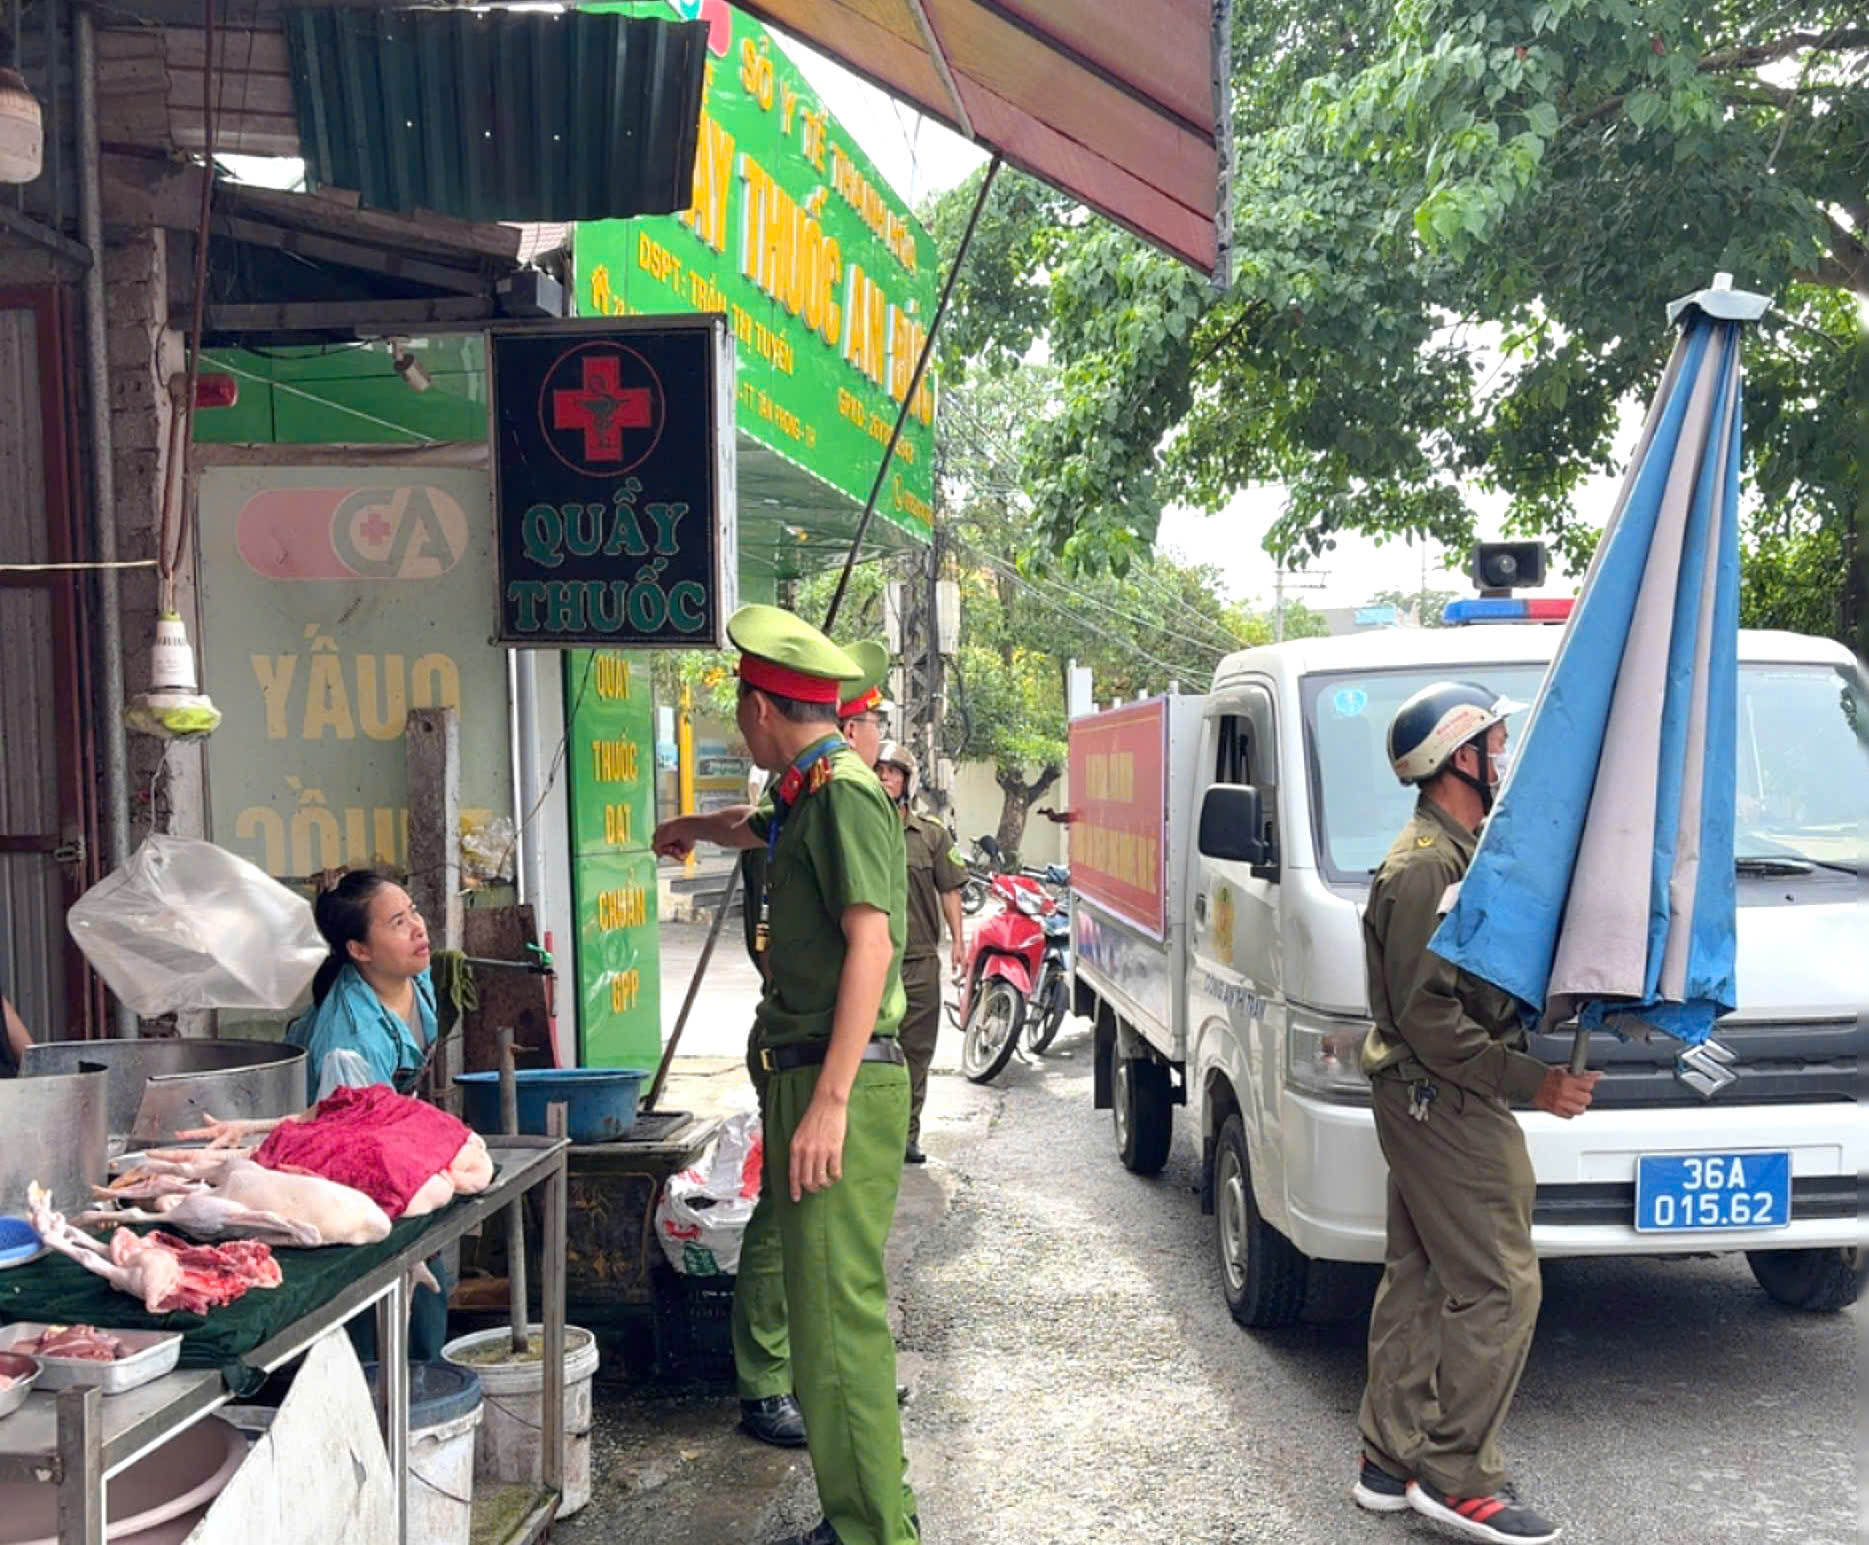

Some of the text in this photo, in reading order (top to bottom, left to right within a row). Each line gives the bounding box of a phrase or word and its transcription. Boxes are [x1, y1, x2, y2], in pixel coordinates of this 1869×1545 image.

[741, 36, 774, 111] SỞ
[779, 80, 796, 136] Y
[739, 152, 842, 346] THUỐC
[843, 264, 886, 386] AN
[508, 556, 706, 634] THUỐC
[592, 727, 639, 783] THUỐC
[604, 803, 632, 850] ĐẠT
[1682, 1156, 1747, 1190] 36A
[1654, 1191, 1774, 1226] 015.62
